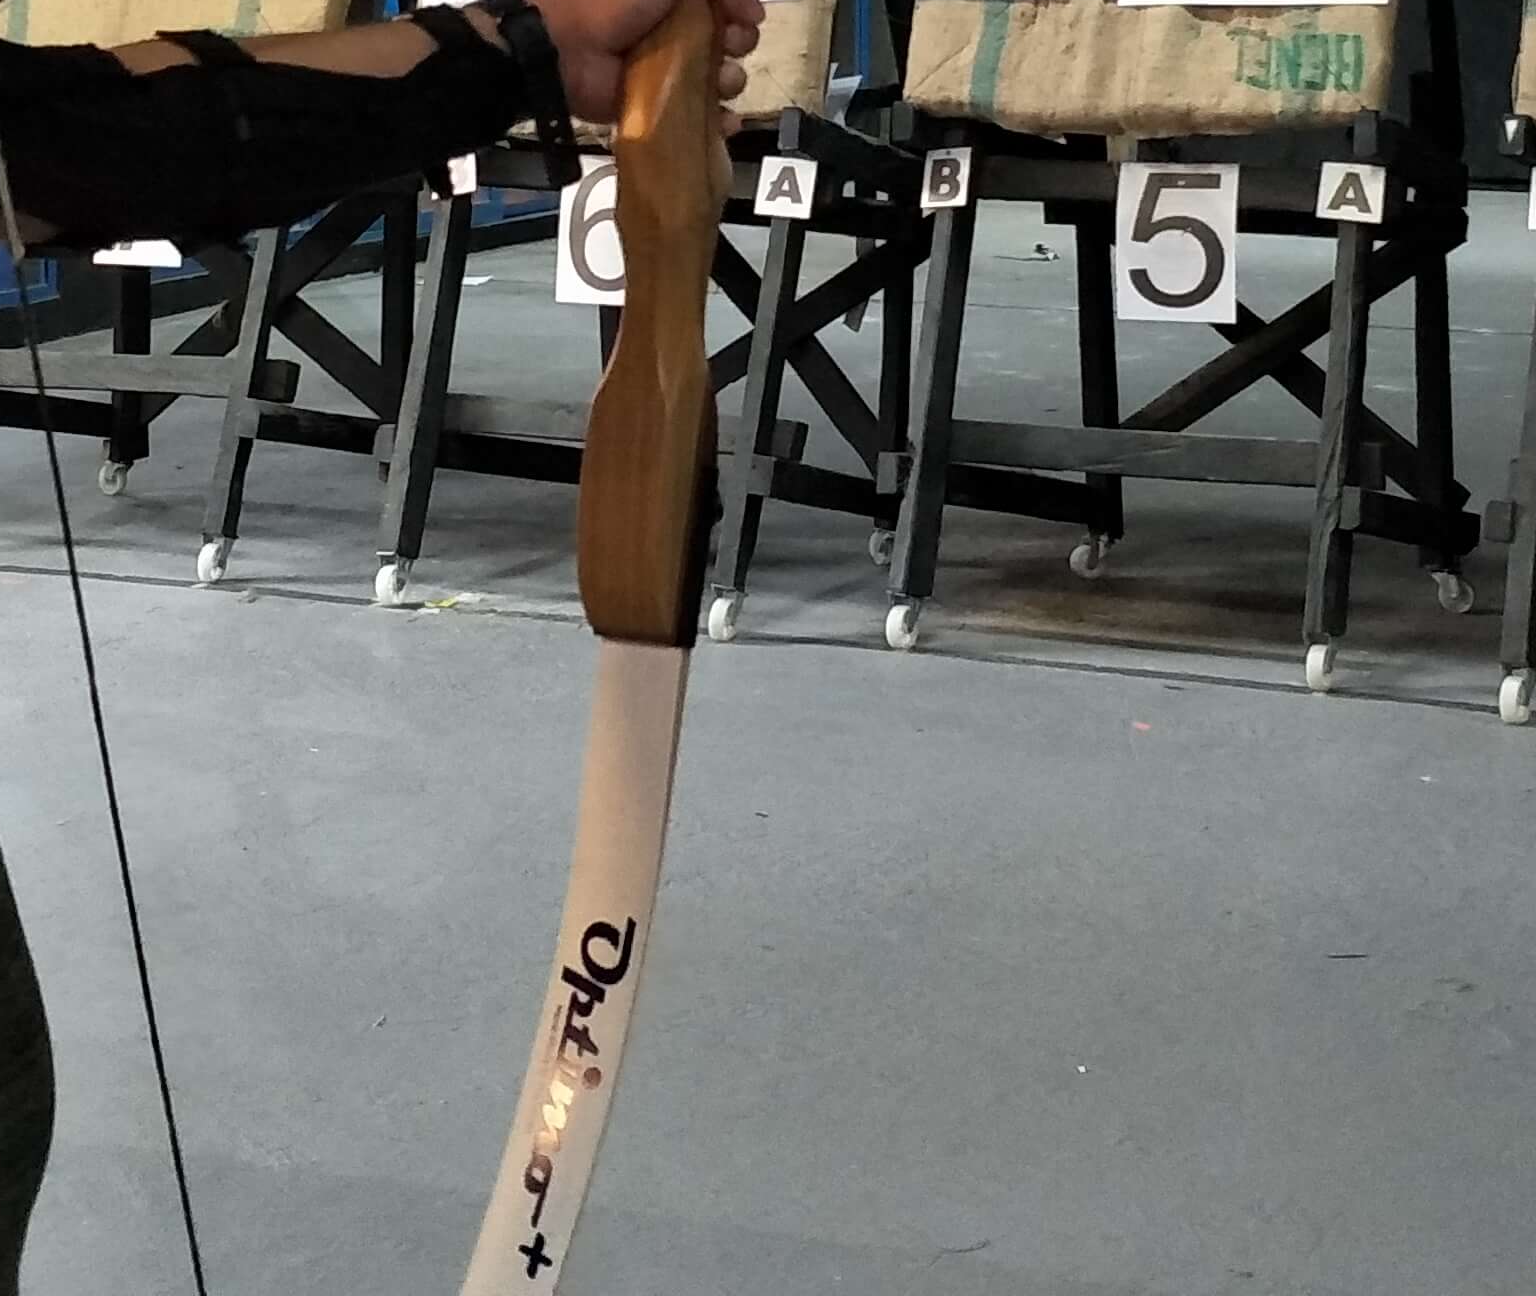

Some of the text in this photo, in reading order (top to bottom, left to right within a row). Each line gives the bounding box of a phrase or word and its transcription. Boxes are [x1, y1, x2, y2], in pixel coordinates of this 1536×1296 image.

[764, 165, 804, 205] A
[928, 157, 962, 203] B
[1326, 171, 1373, 215] A
[1127, 172, 1226, 309] 5
